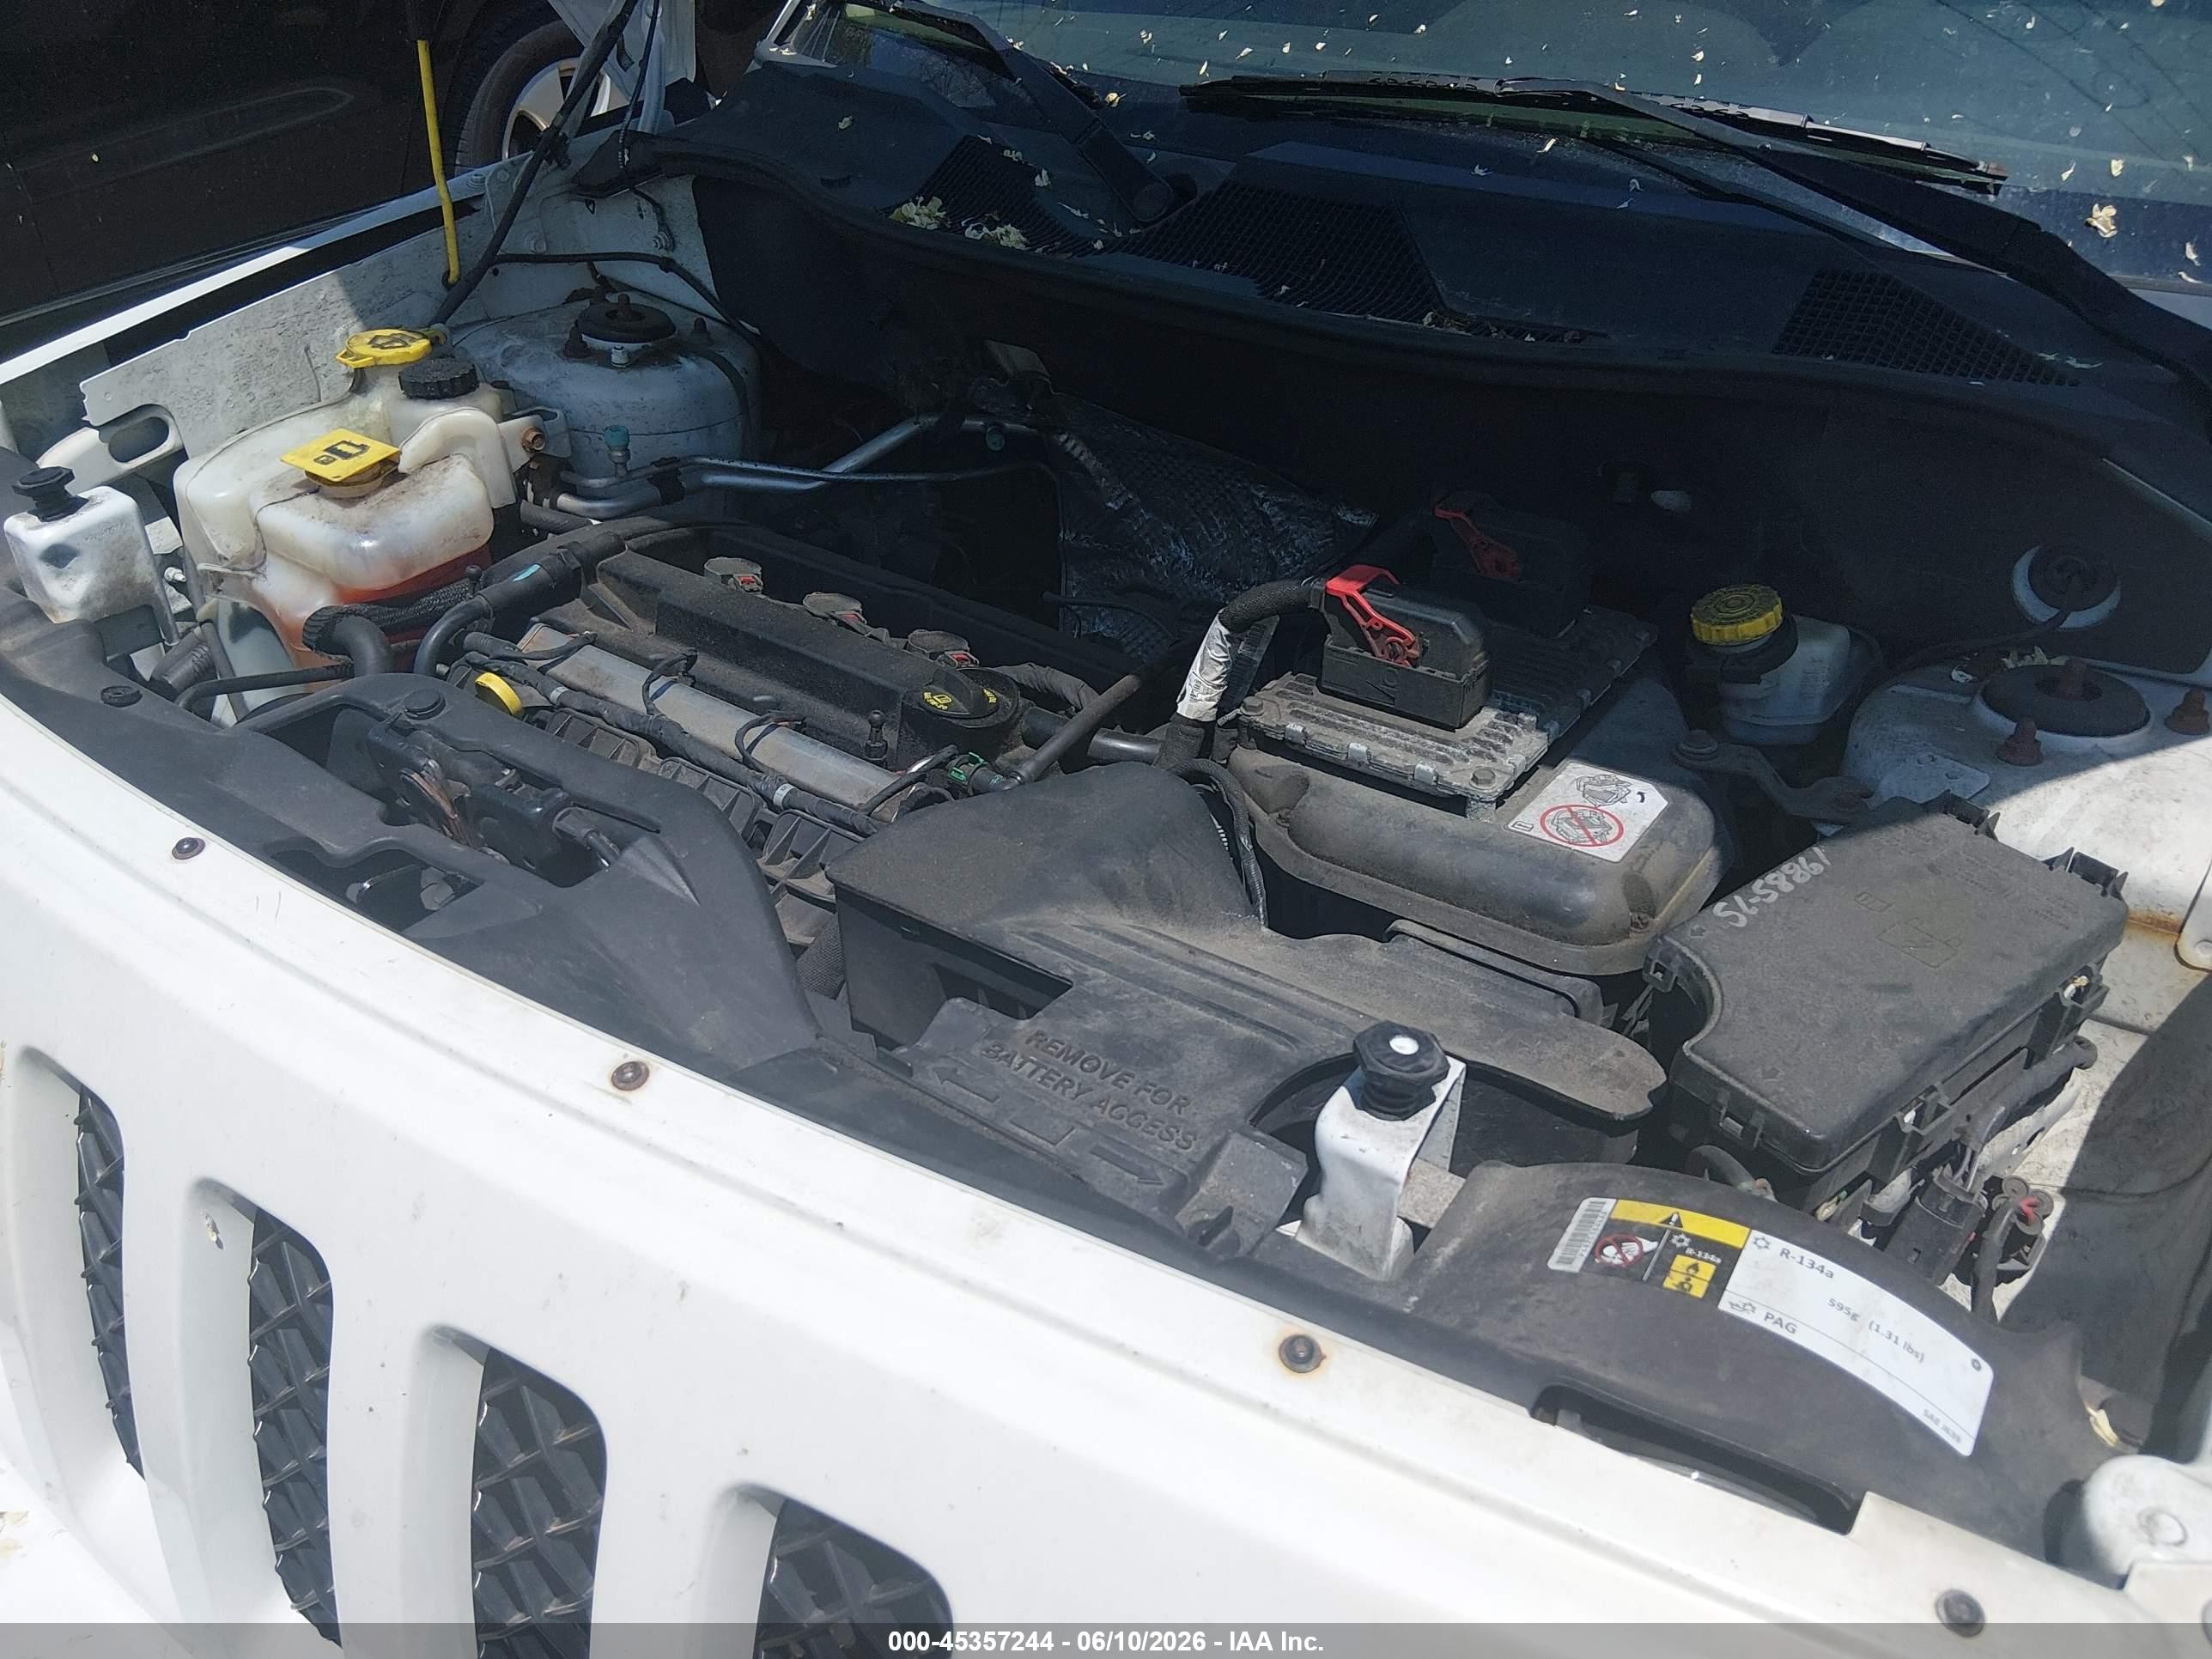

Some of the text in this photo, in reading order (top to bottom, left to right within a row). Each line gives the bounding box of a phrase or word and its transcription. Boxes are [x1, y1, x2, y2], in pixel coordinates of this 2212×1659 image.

[982, 1043, 1197, 1151] BATTERY ACCESS
[1025, 1030, 1191, 1115] REMOVE FOR
[1779, 1248, 1834, 1279] R-134a
[1764, 1311, 1797, 1334] PAG
[1828, 1297, 1861, 1322] 595g
[1903, 1341, 1924, 1364] lbs)
